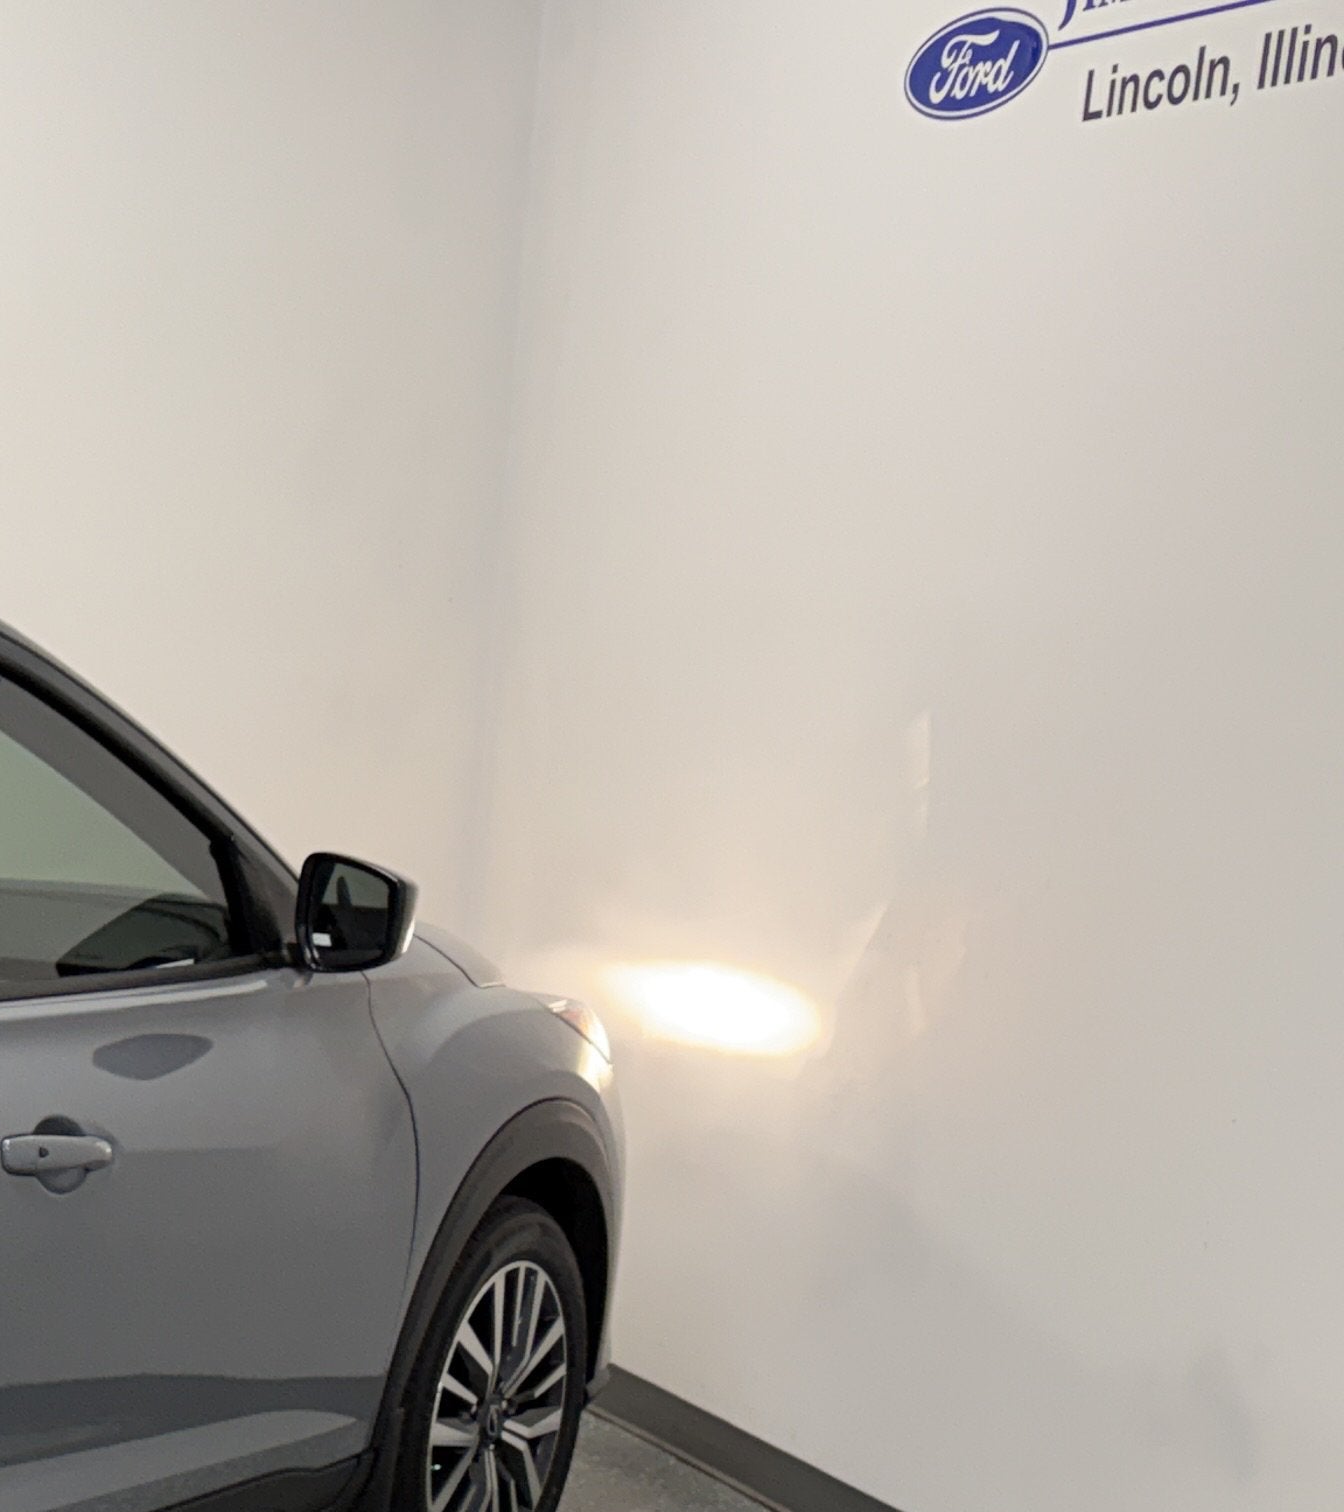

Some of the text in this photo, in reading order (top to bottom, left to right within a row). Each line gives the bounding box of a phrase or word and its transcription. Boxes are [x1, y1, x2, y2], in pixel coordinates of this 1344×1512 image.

[929, 28, 1021, 104] Ford
[1081, 24, 1344, 122] Lincoln, Illin
